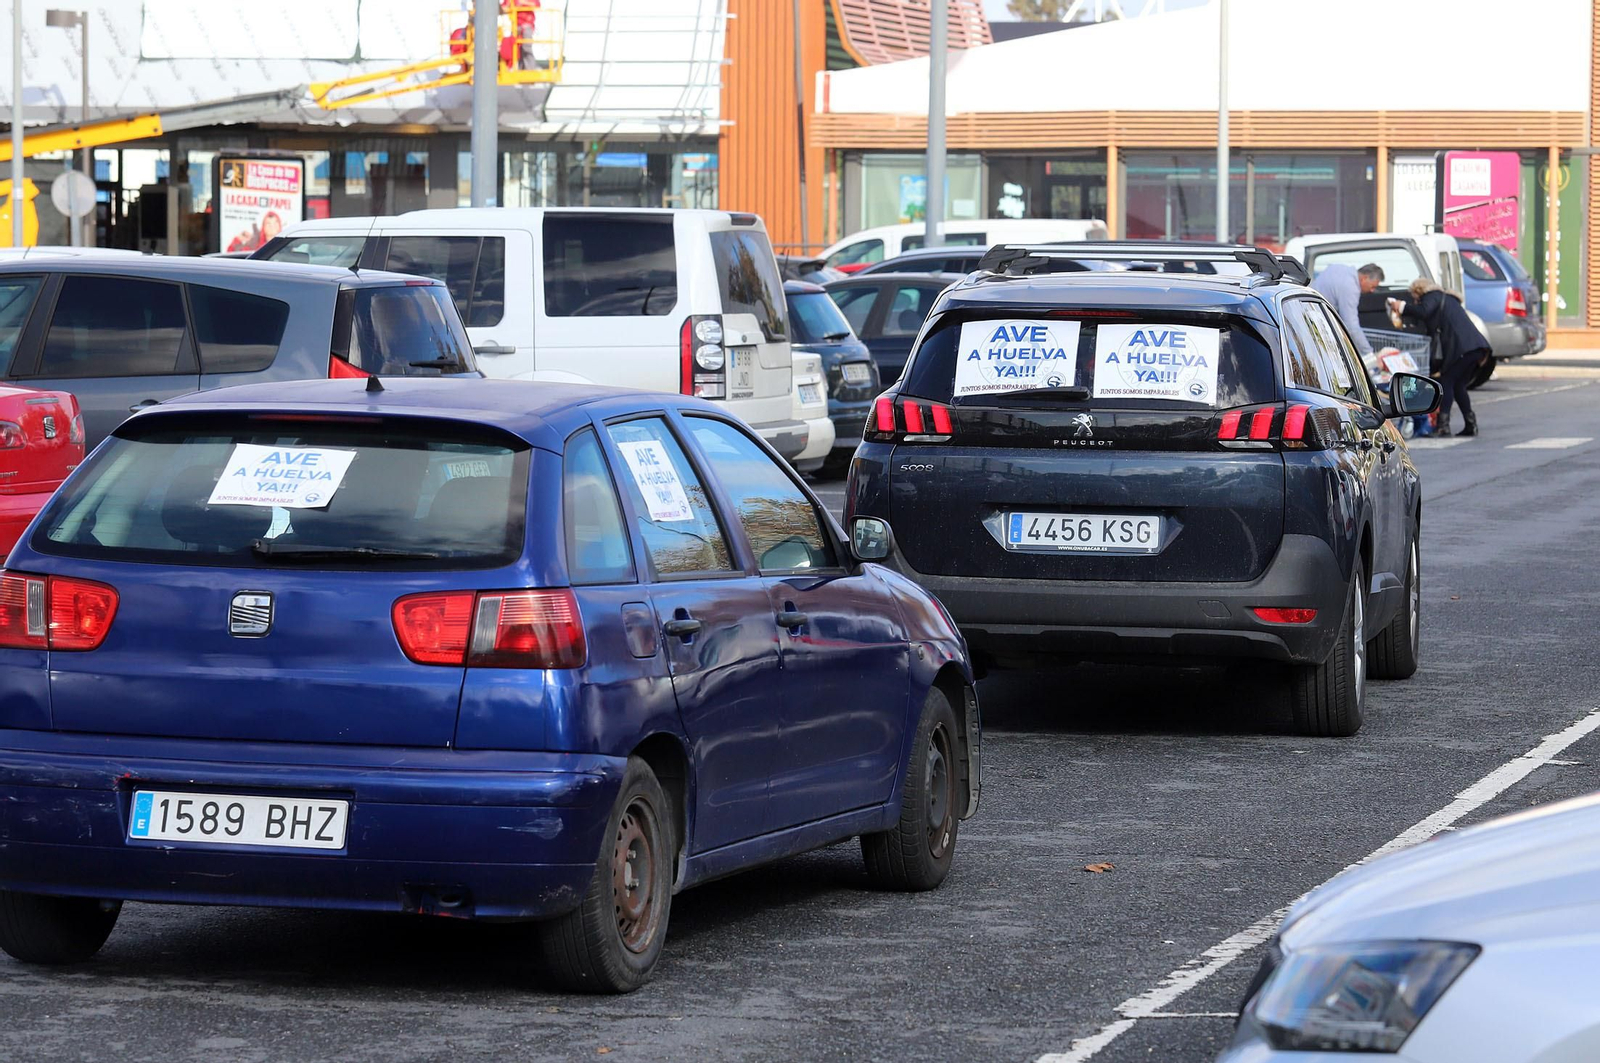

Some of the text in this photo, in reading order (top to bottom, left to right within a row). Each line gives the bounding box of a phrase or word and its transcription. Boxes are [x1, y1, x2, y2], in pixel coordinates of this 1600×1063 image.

[990, 325, 1048, 343] AVE
[1128, 330, 1187, 348] AVE
[967, 348, 1068, 361] A HUELVA
[1105, 352, 1208, 368] A HUELVA
[993, 365, 1036, 378] YA!!!
[1133, 370, 1178, 383] YA!!!
[960, 384, 981, 393] JUNTOS
[981, 383, 1001, 391] SOMOS
[261, 451, 322, 466] AVE
[634, 447, 660, 466] AVE
[232, 467, 332, 481] A HUELVA
[900, 464, 934, 472] 5008
[638, 470, 677, 486] A HUELVA
[257, 482, 299, 493] YA!!!
[1027, 517, 1092, 542] 4456
[1102, 519, 1151, 543] KSG
[137, 799, 337, 842] E 1589 BHZ
